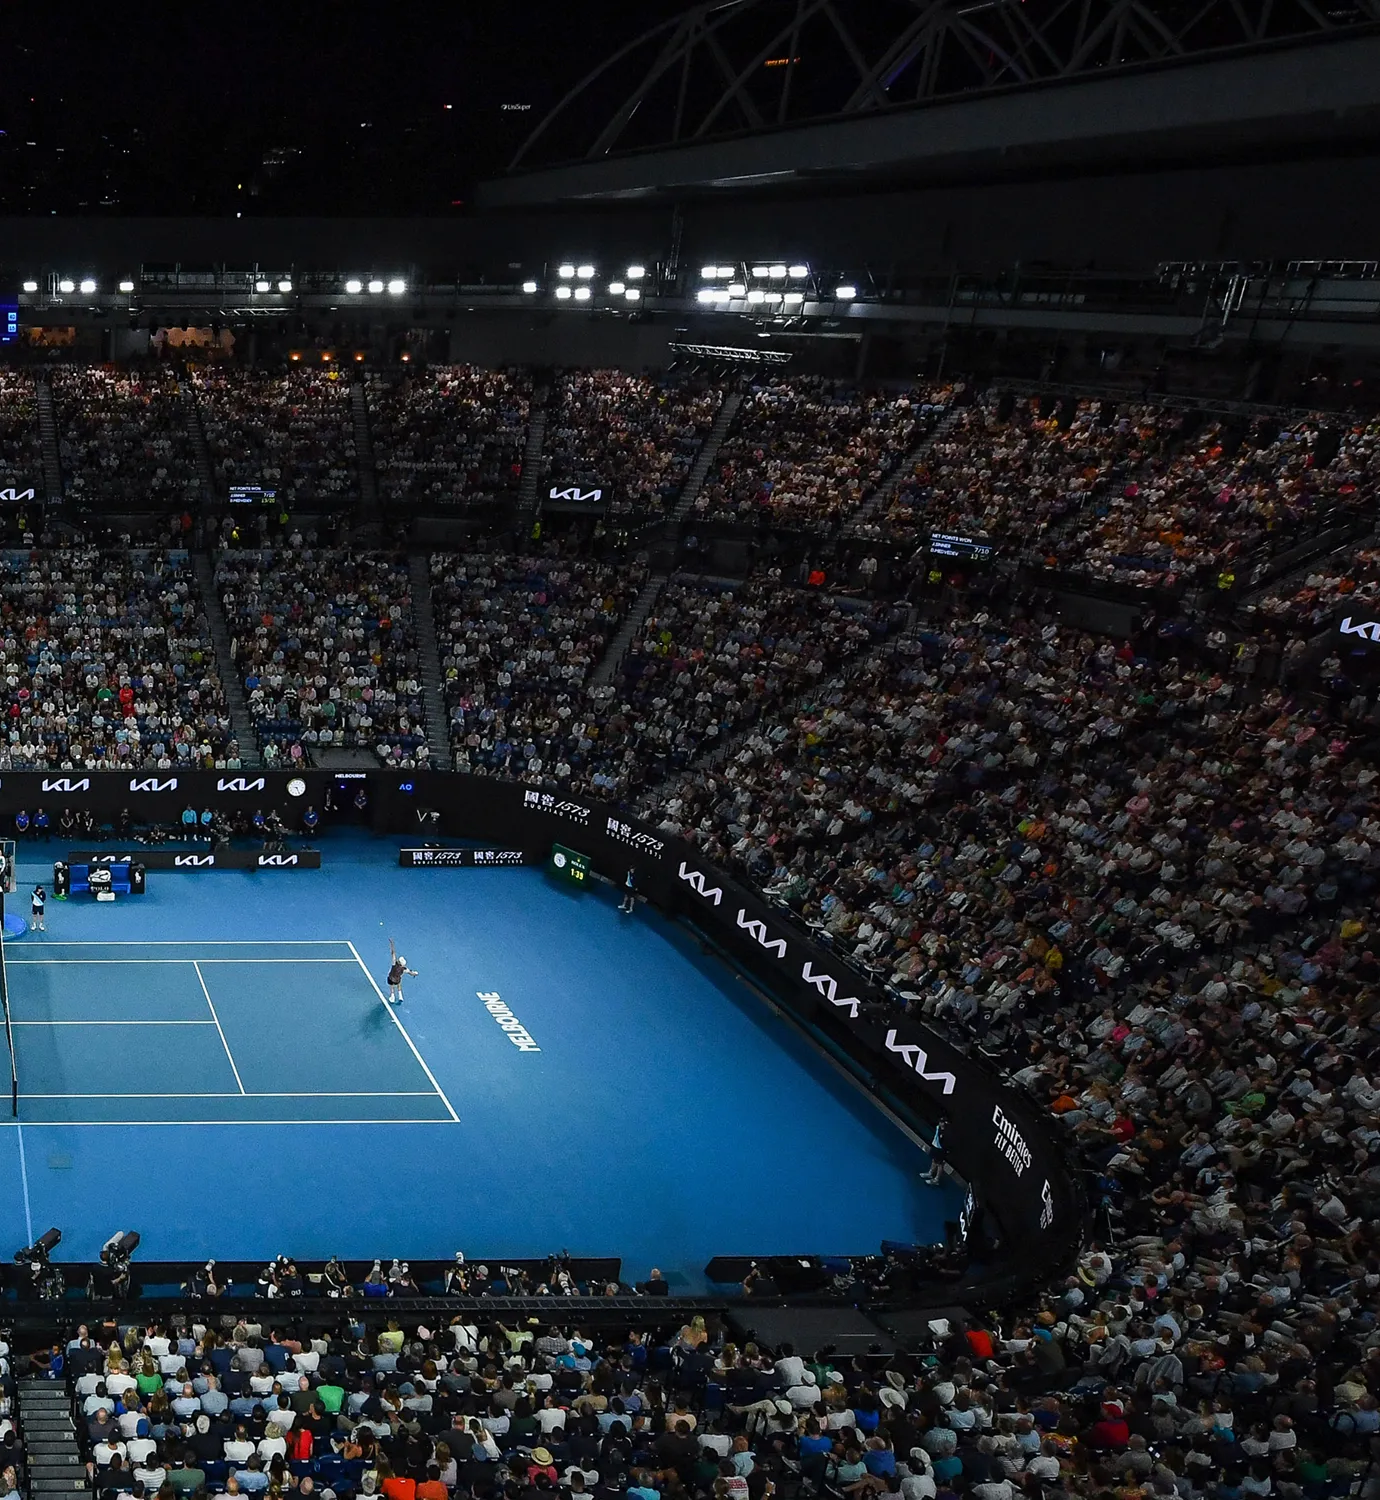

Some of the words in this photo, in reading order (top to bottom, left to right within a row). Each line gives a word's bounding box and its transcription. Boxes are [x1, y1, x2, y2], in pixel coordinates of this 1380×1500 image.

[550, 487, 601, 501] KIA
[42, 778, 89, 791] KIA
[130, 778, 177, 791] KIA
[217, 778, 265, 791] KIA
[175, 855, 214, 866] KIA
[258, 855, 298, 865] KIA
[679, 862, 722, 905] KIA
[737, 908, 787, 958] KIA
[802, 962, 860, 1018] KIA
[476, 992, 541, 1051] MELBOURNE
[885, 1029, 956, 1094] KIA
[992, 1104, 1032, 1168] Emirates
[994, 1132, 1007, 1151] FLY
[1005, 1144, 1024, 1178] BETTER
